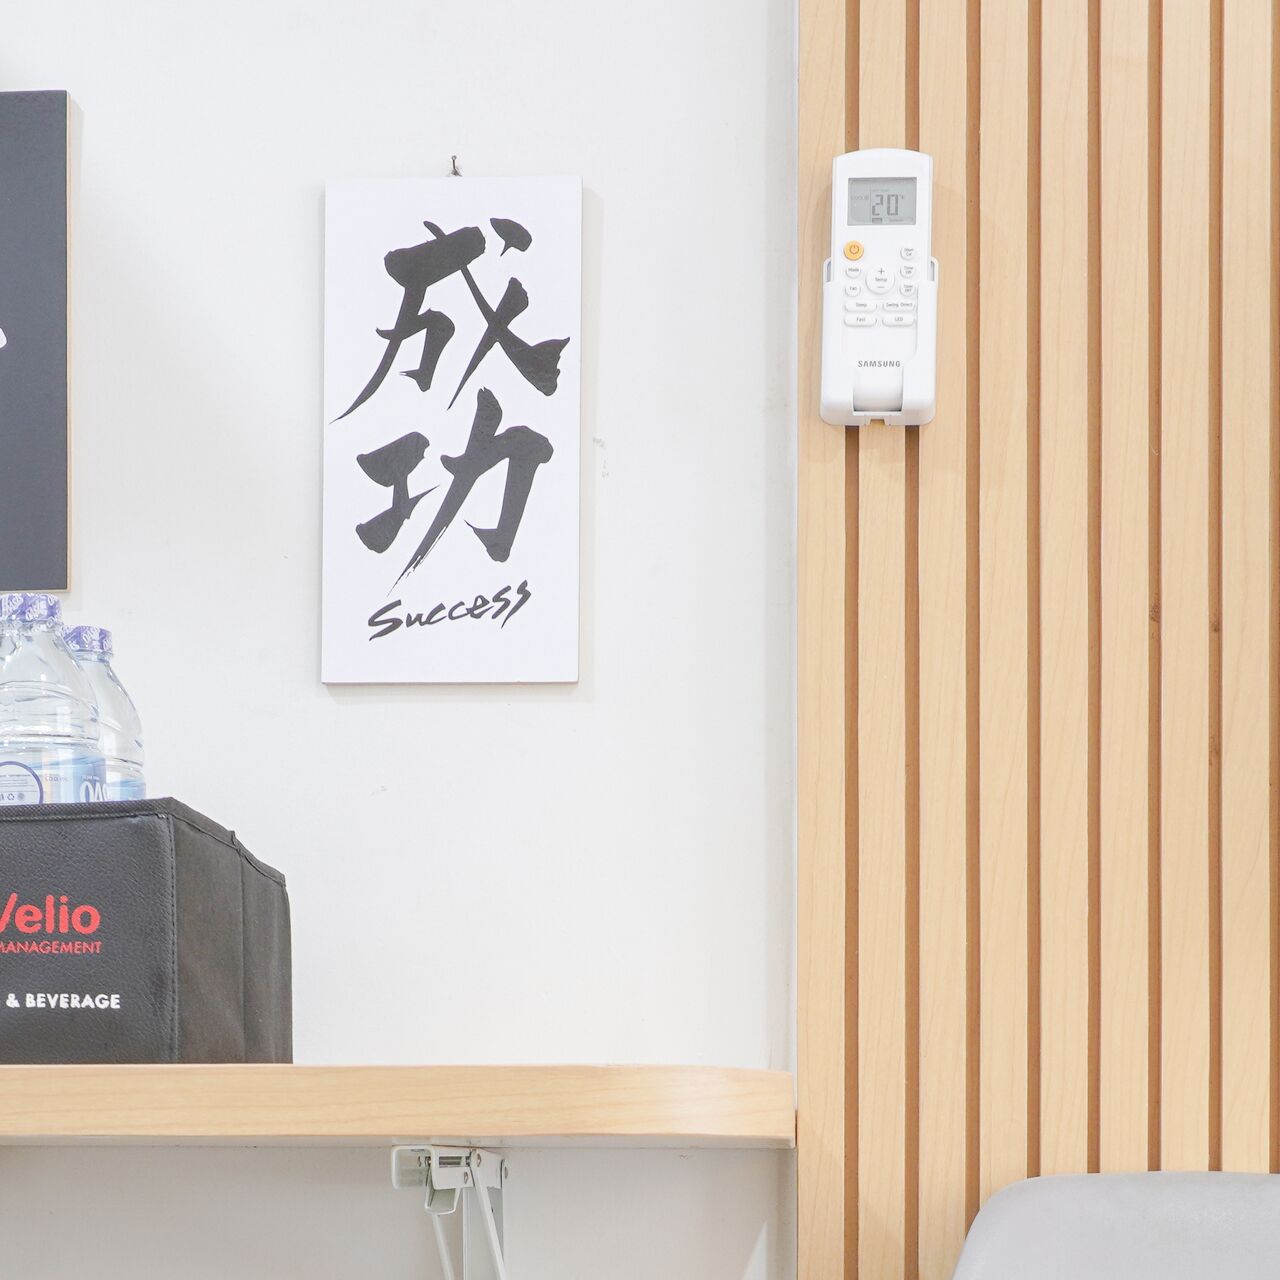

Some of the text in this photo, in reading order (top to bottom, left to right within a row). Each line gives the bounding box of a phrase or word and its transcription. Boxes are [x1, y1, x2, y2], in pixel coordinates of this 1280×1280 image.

[871, 193, 899, 216] 20
[857, 359, 901, 368] SAMSUNG
[329, 217, 571, 596] 成功
[367, 579, 532, 642] Success
[5, 993, 21, 1008] &
[25, 993, 121, 1009] BEVERAGE
